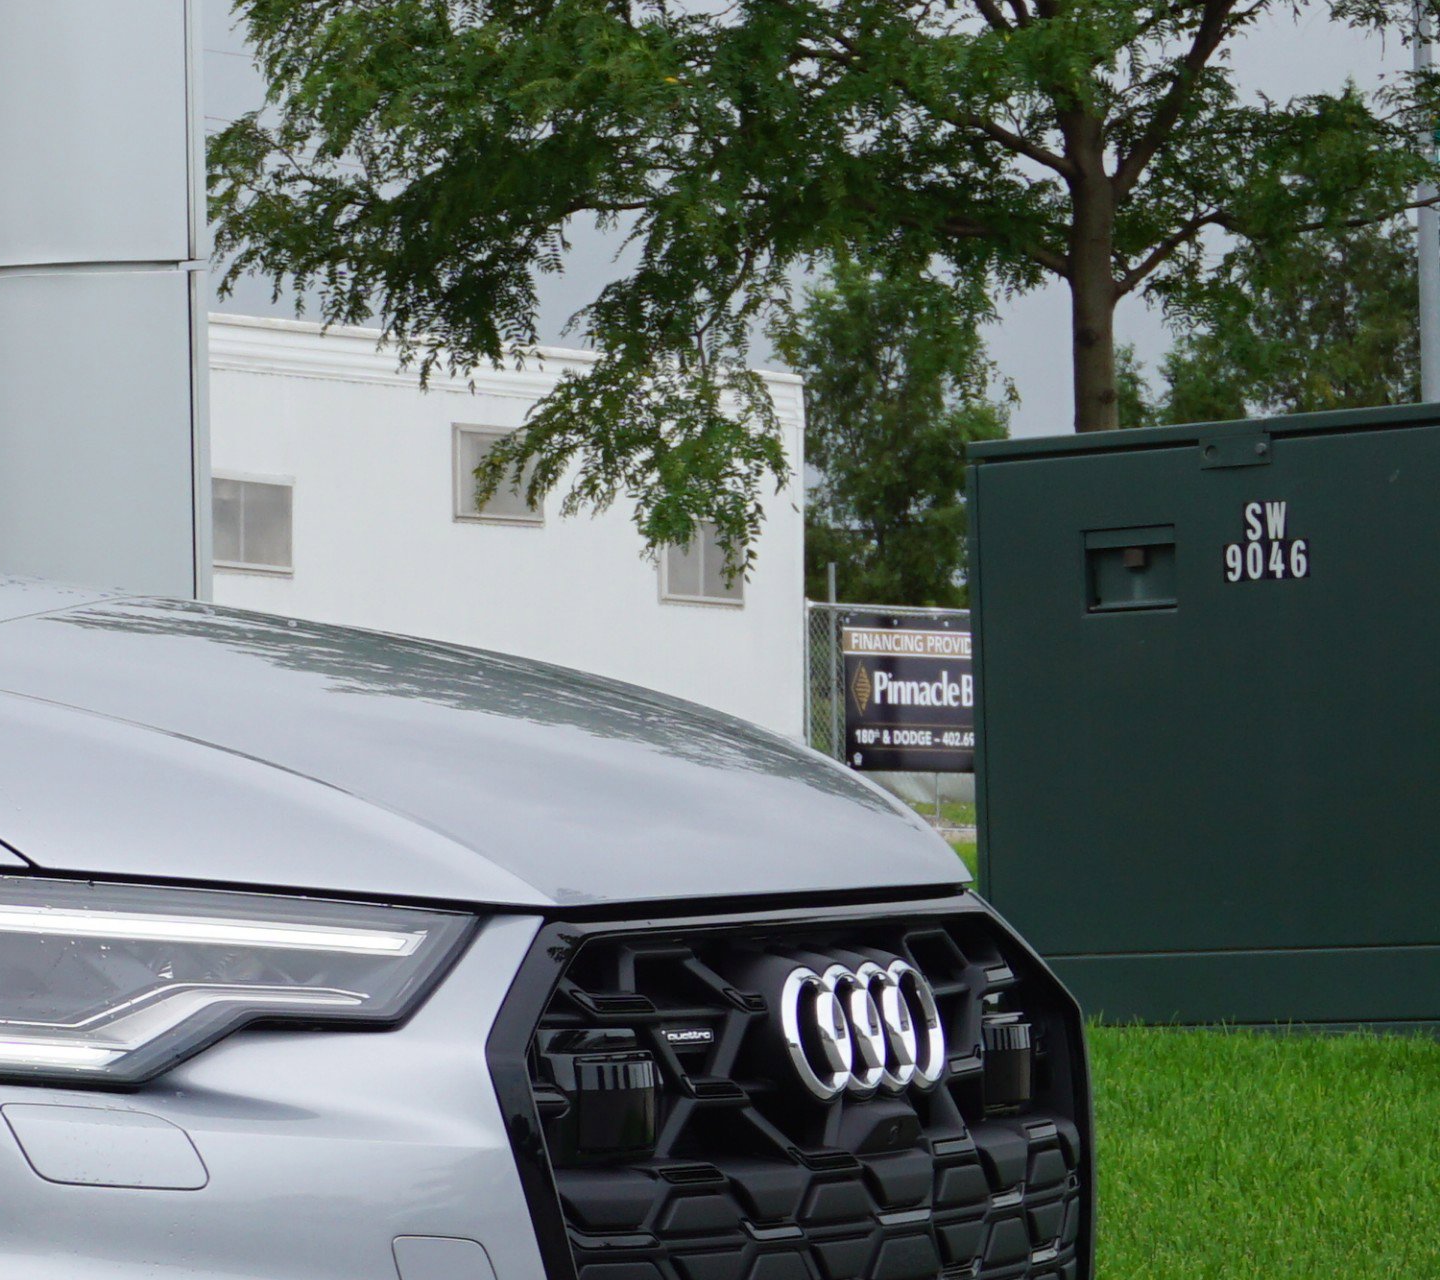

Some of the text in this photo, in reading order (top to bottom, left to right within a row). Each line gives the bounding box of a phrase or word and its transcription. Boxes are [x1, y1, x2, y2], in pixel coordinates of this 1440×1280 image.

[1245, 501, 1286, 541] SW
[1225, 539, 1307, 582] 9046
[851, 632, 923, 652] FINANCING
[883, 730, 891, 745] &
[893, 730, 932, 745] DODGE
